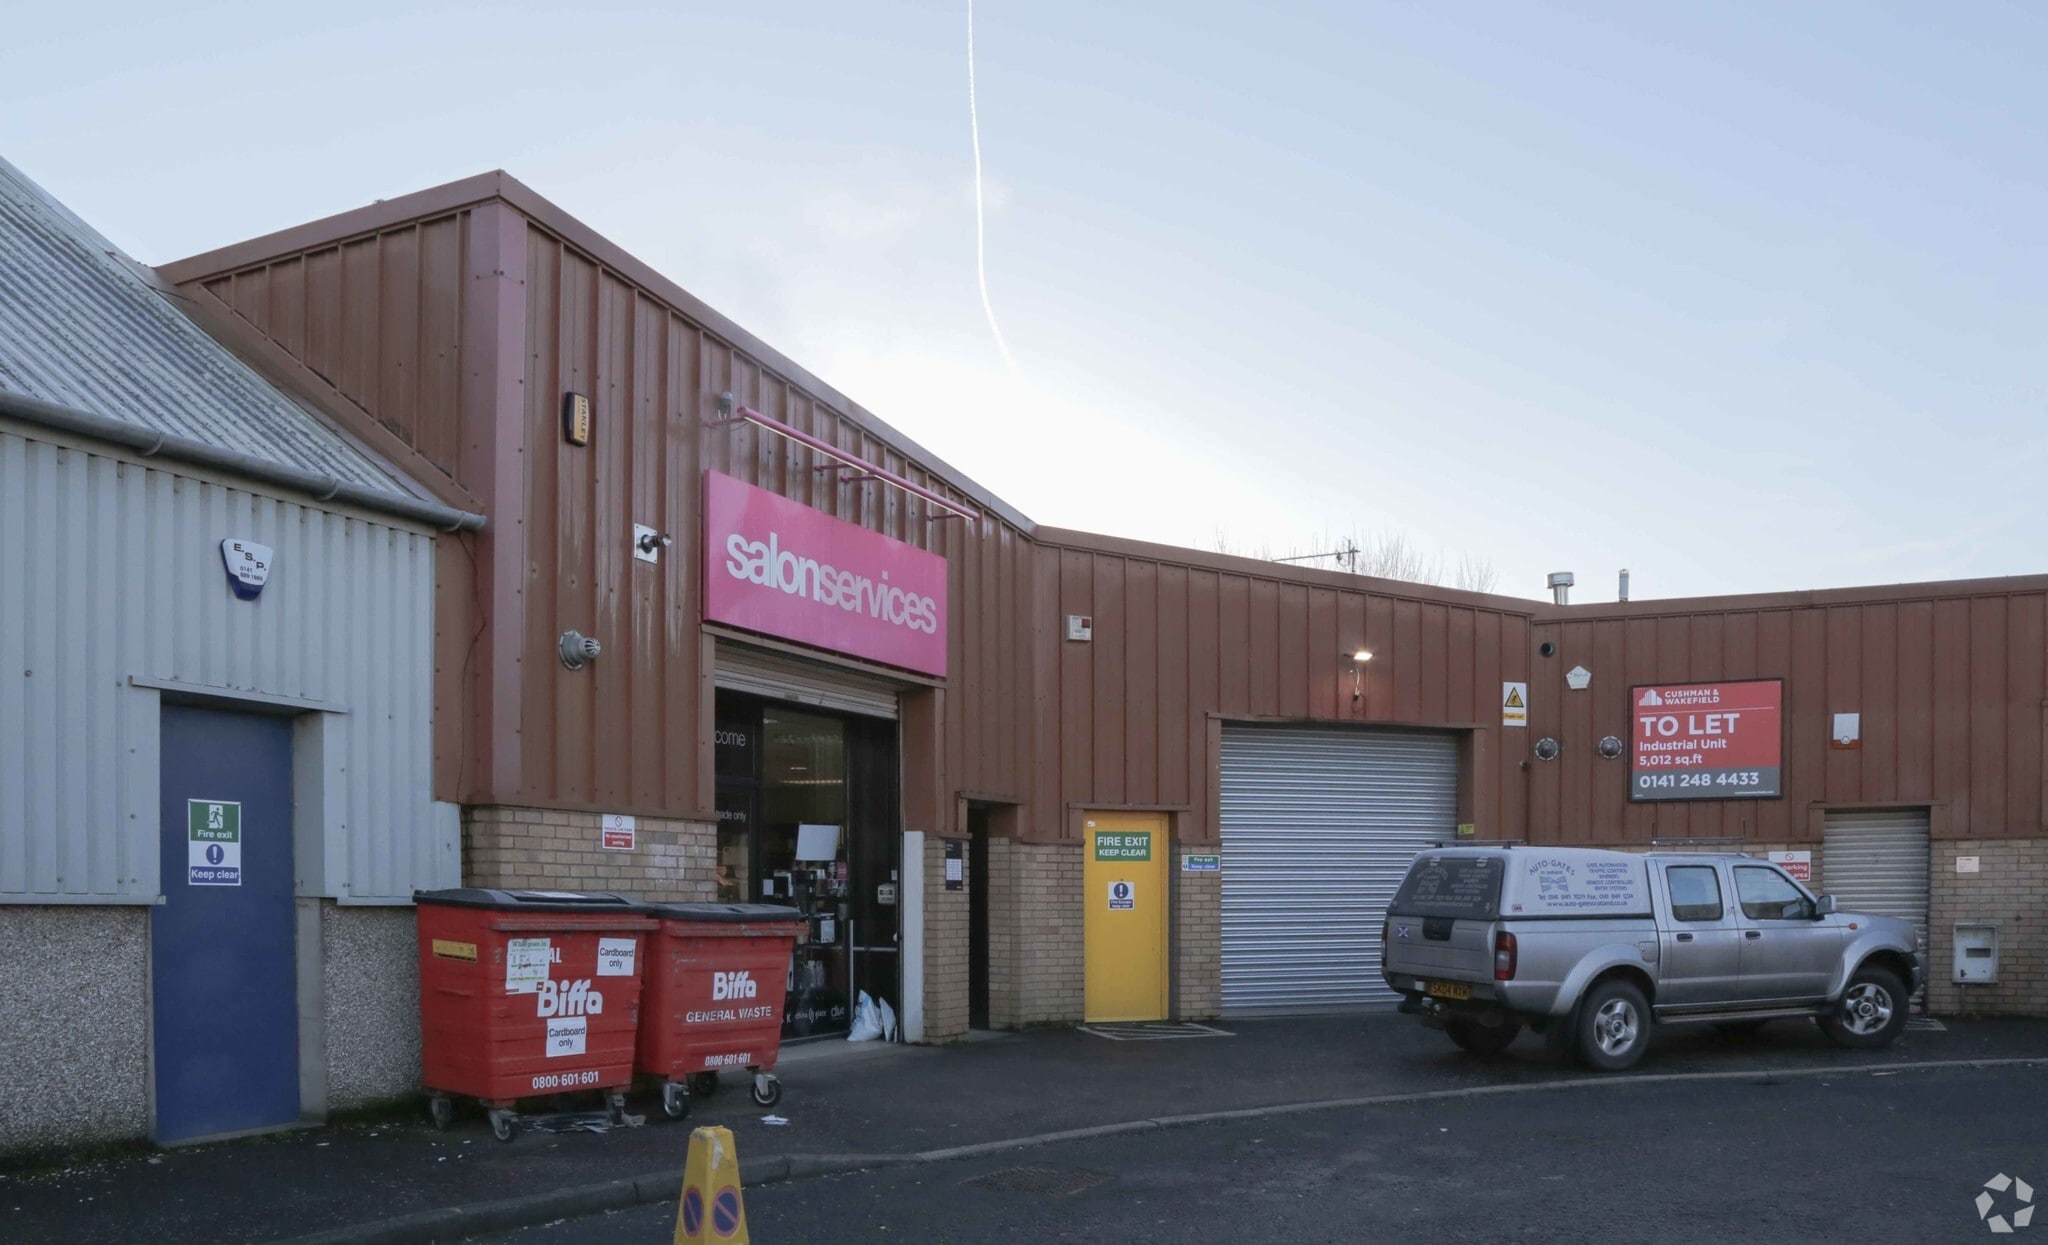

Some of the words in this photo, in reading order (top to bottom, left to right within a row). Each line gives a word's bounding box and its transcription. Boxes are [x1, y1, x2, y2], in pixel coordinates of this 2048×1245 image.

[726, 531, 937, 635] salonservices
[1664, 689, 1707, 698] CUSHMAN
[1664, 697, 1720, 705] WAKEFIELD
[1639, 715, 1679, 737] TO
[1689, 713, 1741, 736] LET
[1639, 739, 1697, 752] Industrial
[1701, 738, 1727, 749] Unit
[1639, 755, 1672, 767] 5,012
[1675, 754, 1703, 766] sq.ft
[1639, 775, 1675, 788] 0141
[1680, 773, 1711, 787] 248
[1716, 772, 1759, 785] 4433
[197, 829, 215, 838] Fire
[216, 831, 233, 839] exit
[1097, 836, 1121, 847] FIRE
[1125, 836, 1149, 846] EXIT
[1099, 848, 1120, 857] KEEP
[1121, 848, 1147, 857] CLEAR
[191, 868, 215, 880] Keep
[216, 869, 239, 879] clear
[599, 947, 634, 958] Cardboard
[609, 958, 623, 969] only
[713, 971, 757, 1001] Biffa
[537, 979, 604, 1018] Biffa
[686, 1009, 737, 1023] GENERAL
[738, 1006, 772, 1019] WASTE
[548, 1026, 586, 1037] Cardboard
[558, 1038, 574, 1048] only
